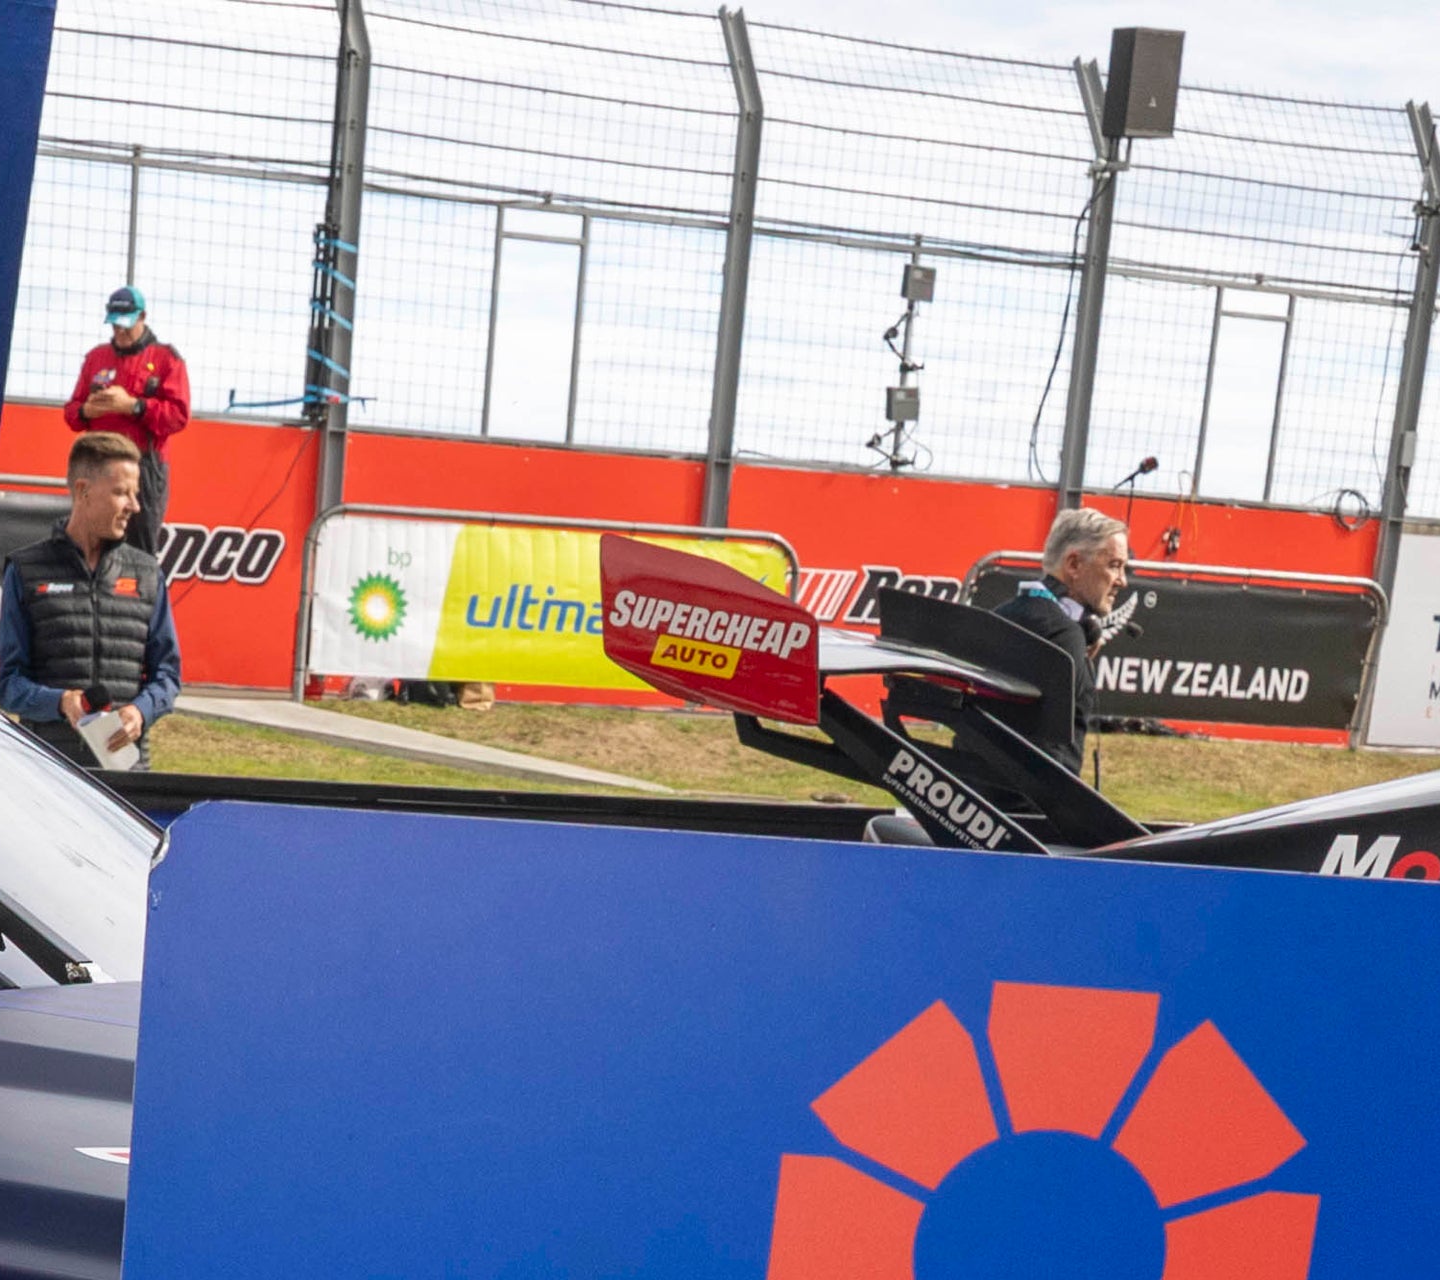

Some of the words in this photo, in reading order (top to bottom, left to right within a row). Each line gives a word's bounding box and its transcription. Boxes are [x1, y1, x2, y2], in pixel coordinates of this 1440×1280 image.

[386, 546, 412, 570] bp
[608, 589, 812, 660] SUPERCHEAP
[660, 641, 730, 671] AUTO
[1097, 655, 1170, 696] NEW
[1172, 660, 1310, 703] ZEALAND
